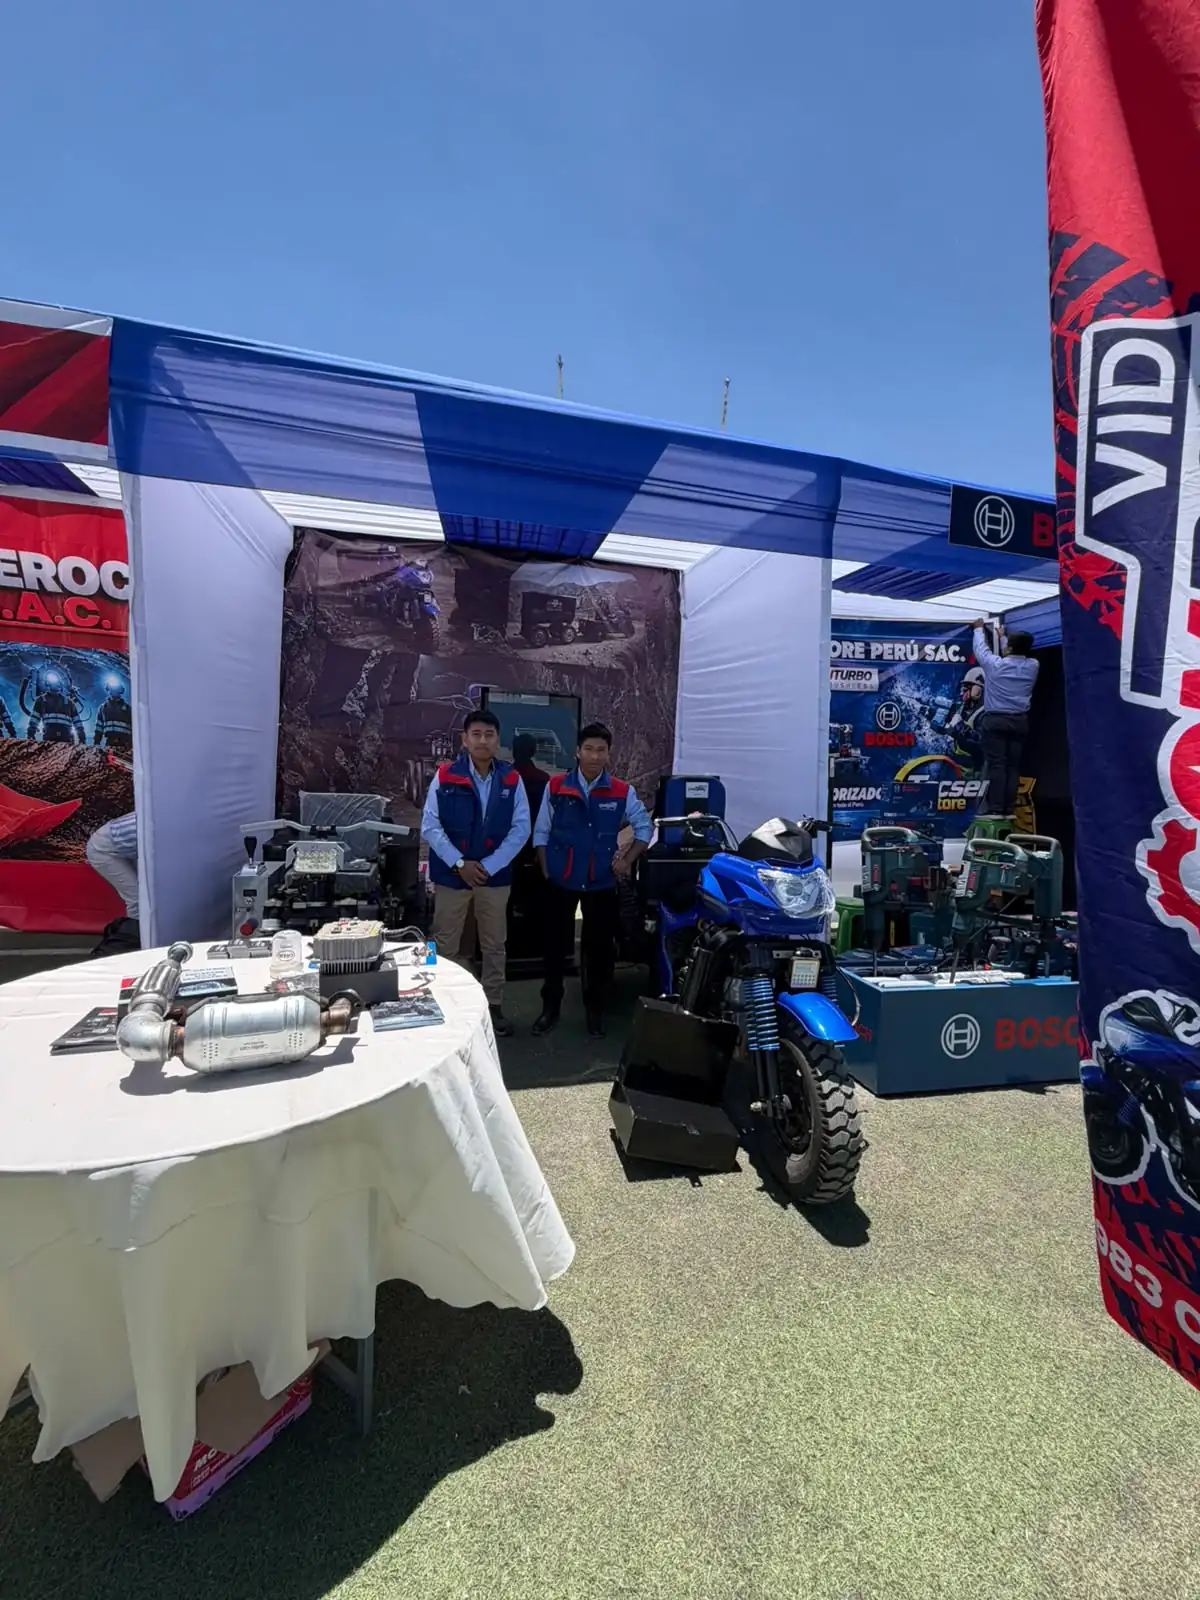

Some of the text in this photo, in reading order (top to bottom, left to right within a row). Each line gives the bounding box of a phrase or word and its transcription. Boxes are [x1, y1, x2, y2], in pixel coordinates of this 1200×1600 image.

[1091, 337, 1176, 516] VID
[1033, 512, 1054, 547] B
[870, 640, 918, 660] PERÚ
[924, 644, 966, 662] SAC.
[864, 733, 915, 747] BOSCH
